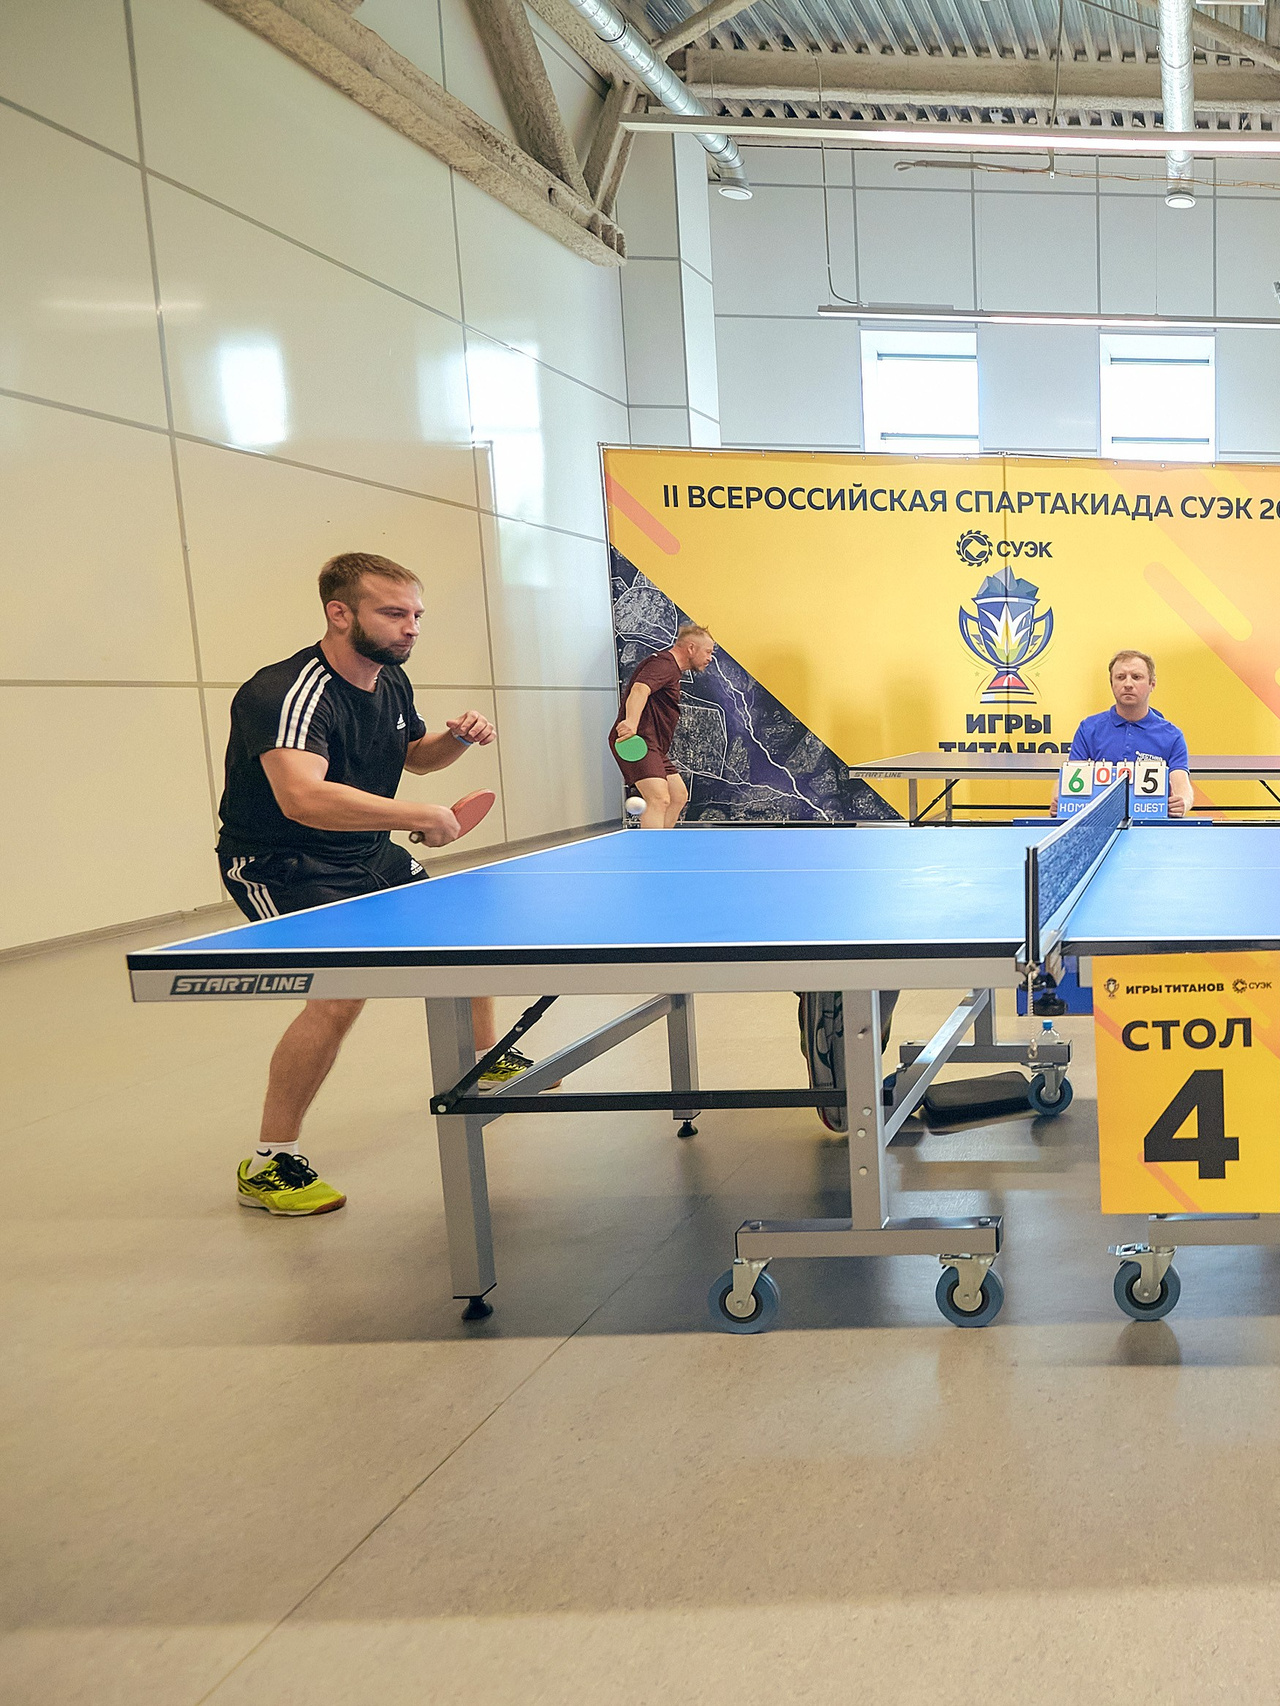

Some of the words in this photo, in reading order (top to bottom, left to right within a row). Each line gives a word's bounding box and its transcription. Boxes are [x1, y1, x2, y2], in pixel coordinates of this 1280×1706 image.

[663, 484, 679, 508] II
[687, 482, 948, 513] ВСЕРОССИЙСКАЯ
[956, 489, 1174, 522] СПАРТАКИАДА
[1180, 495, 1254, 520] СУЭК
[996, 540, 1053, 559] СУЭК
[965, 713, 1052, 735] ИГРЫ
[938, 741, 1072, 754] ТИТАНО
[1068, 767, 1085, 793] 6
[1096, 767, 1110, 784] 0
[1140, 768, 1159, 794] 5
[1059, 802, 1089, 813] HOM
[1133, 802, 1166, 813] GUEST
[174, 976, 256, 993] START
[256, 975, 310, 992] LINE
[1125, 984, 1162, 995] ИГРЫ
[1164, 982, 1225, 994] ТИТАНОВ
[1248, 981, 1273, 990] СУЭК
[1121, 1017, 1253, 1052] СТОЛ
[1143, 1068, 1240, 1180] 4
